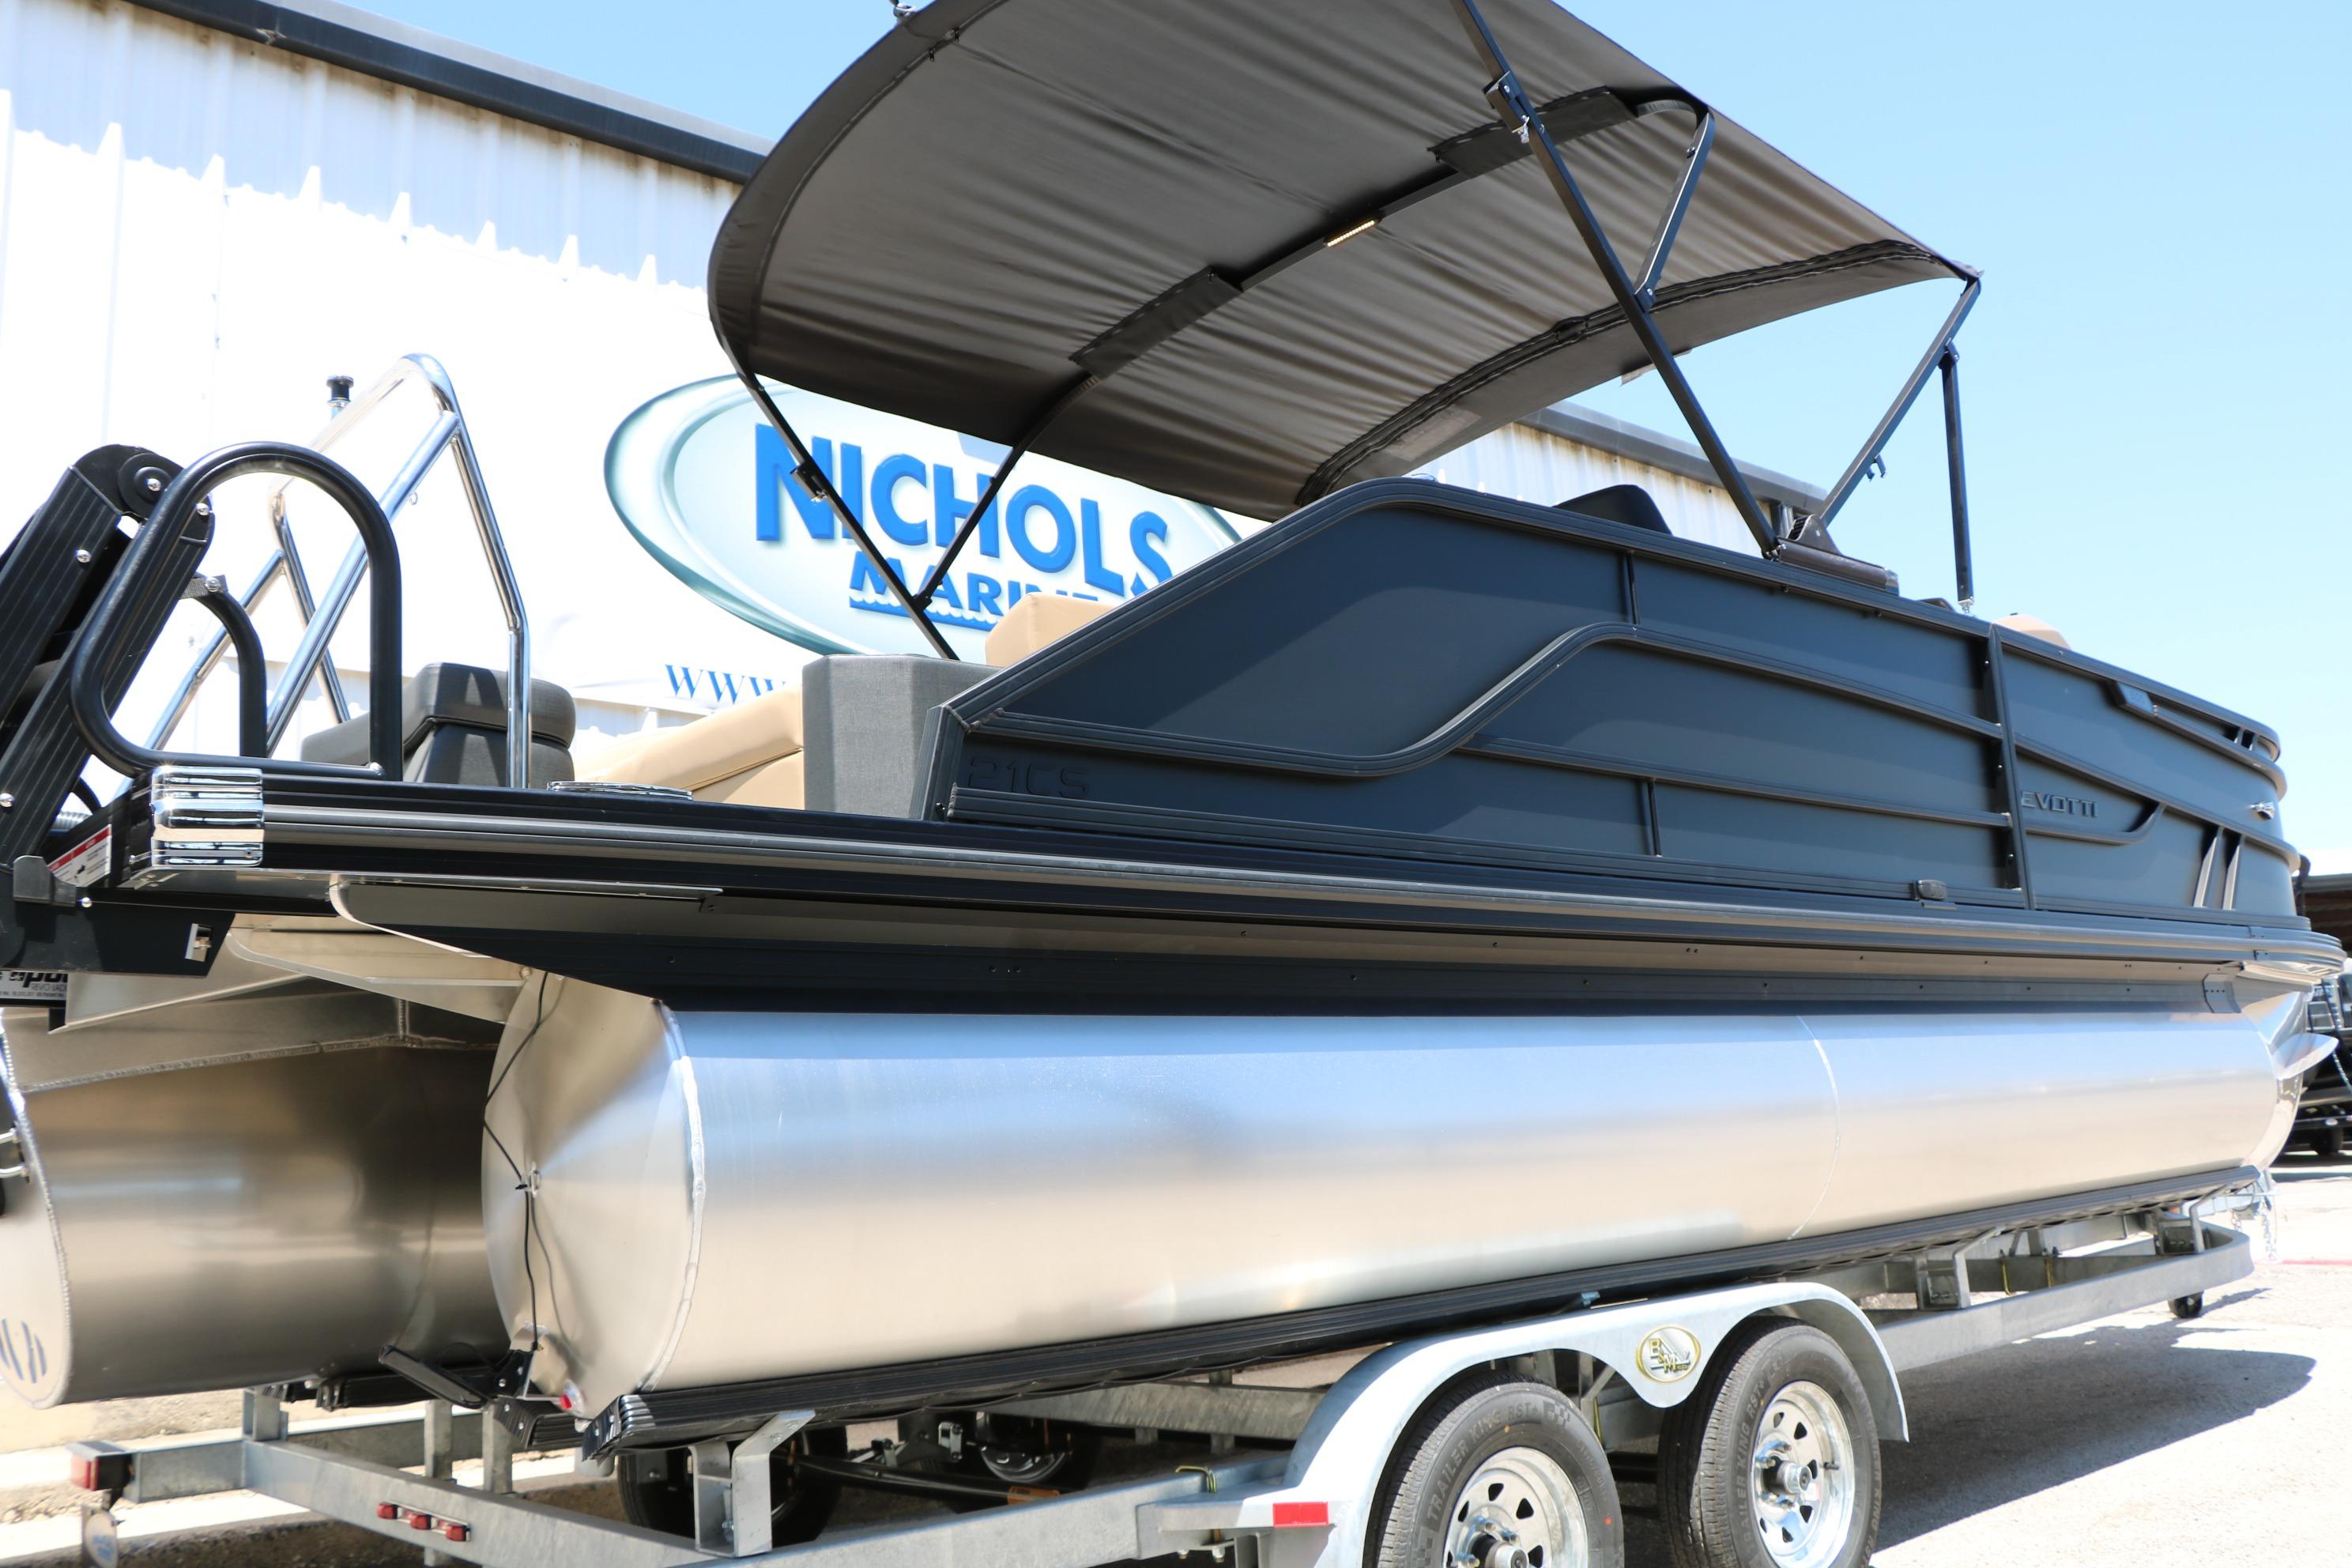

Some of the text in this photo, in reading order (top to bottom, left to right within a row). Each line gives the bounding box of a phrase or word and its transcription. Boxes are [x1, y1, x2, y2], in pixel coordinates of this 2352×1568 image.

[755, 422, 1173, 597] NICHOLS
[850, 551, 1099, 617] MARI
[2021, 790, 2098, 818] EVOTTI
[1427, 1440, 1469, 1521] TRAILER
[1468, 1408, 1502, 1444] KING
